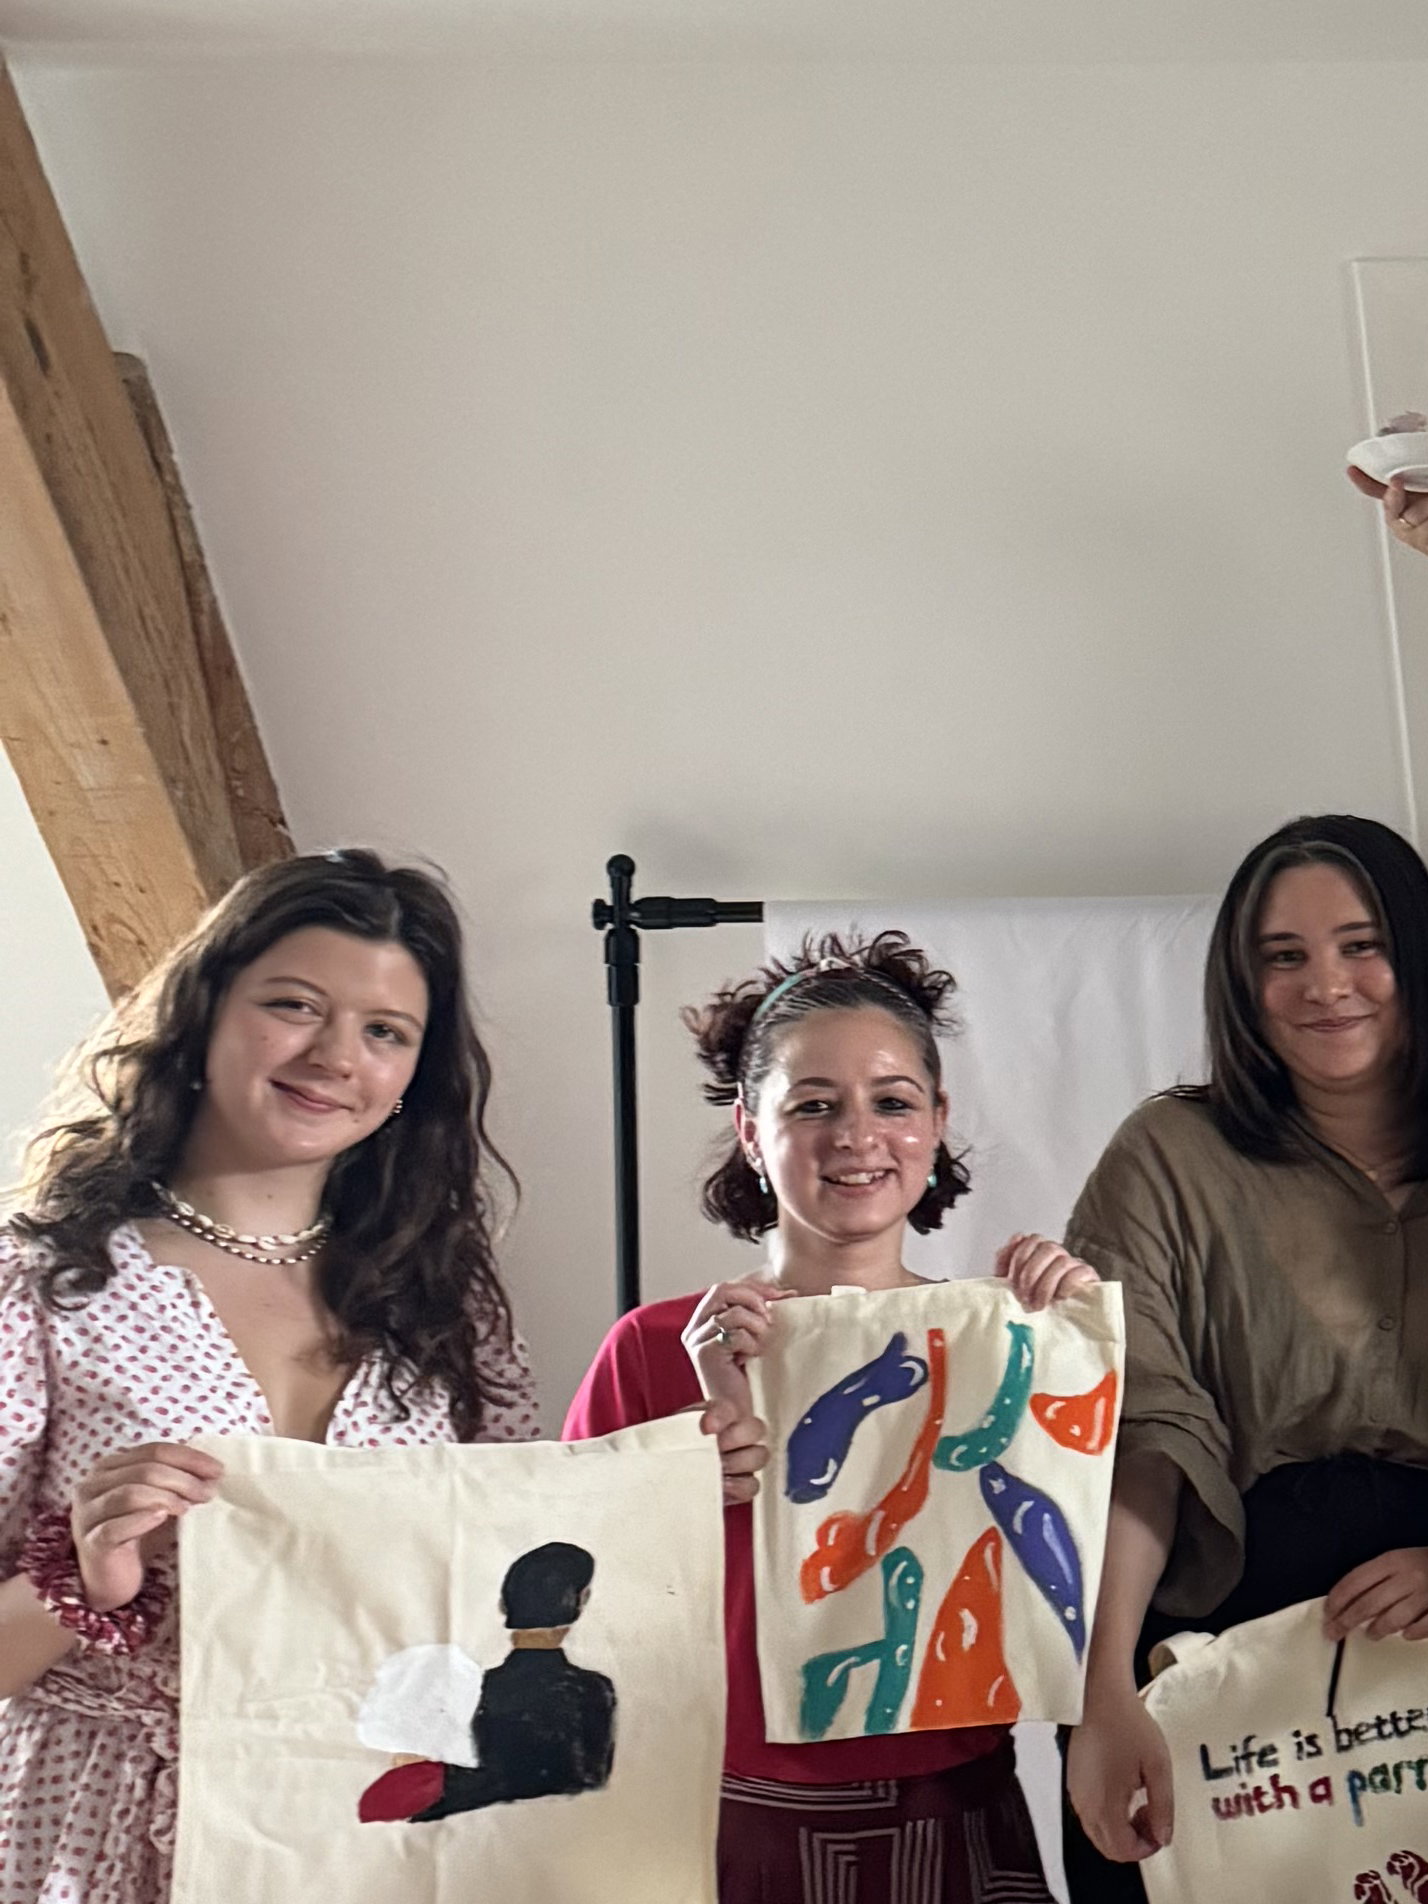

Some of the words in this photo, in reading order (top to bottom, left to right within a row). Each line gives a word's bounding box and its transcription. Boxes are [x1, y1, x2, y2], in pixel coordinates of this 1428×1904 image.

[1200, 1734, 1279, 1782] Life
[1291, 1729, 1323, 1761] is
[1211, 1773, 1300, 1821] with
[1309, 1775, 1333, 1807] a
